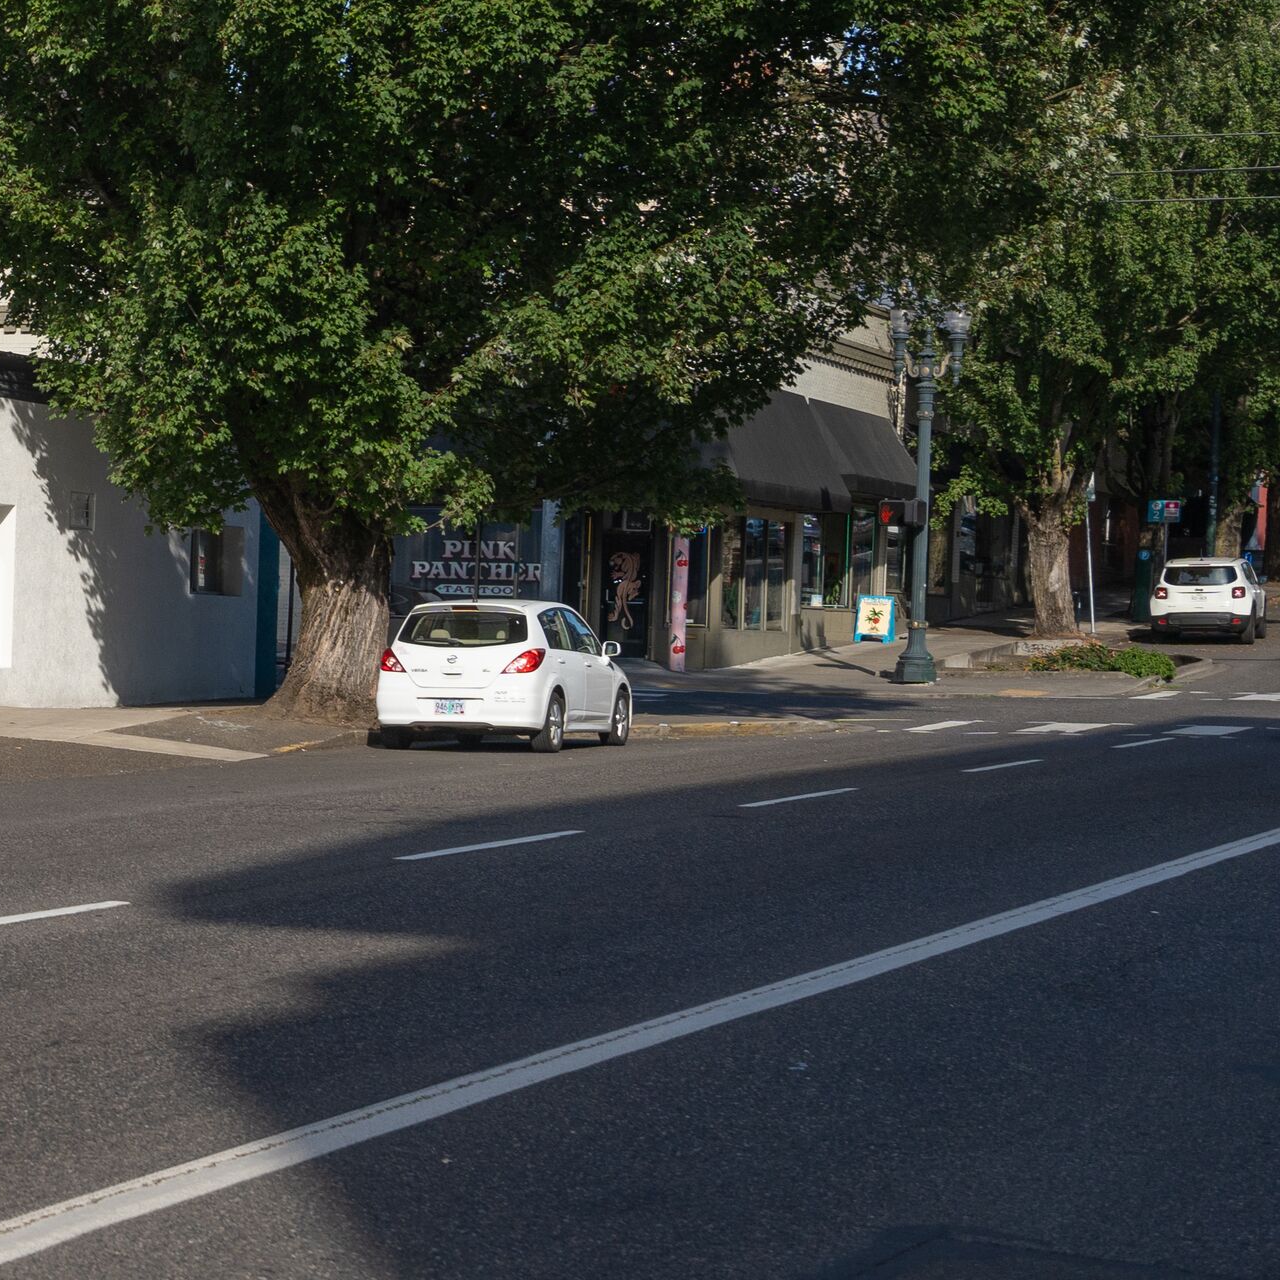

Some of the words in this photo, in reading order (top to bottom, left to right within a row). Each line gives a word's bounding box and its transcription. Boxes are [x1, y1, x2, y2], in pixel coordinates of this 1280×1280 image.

[442, 540, 515, 560] PINK
[411, 560, 541, 582] PANTHER
[444, 585, 513, 595] TATTOO
